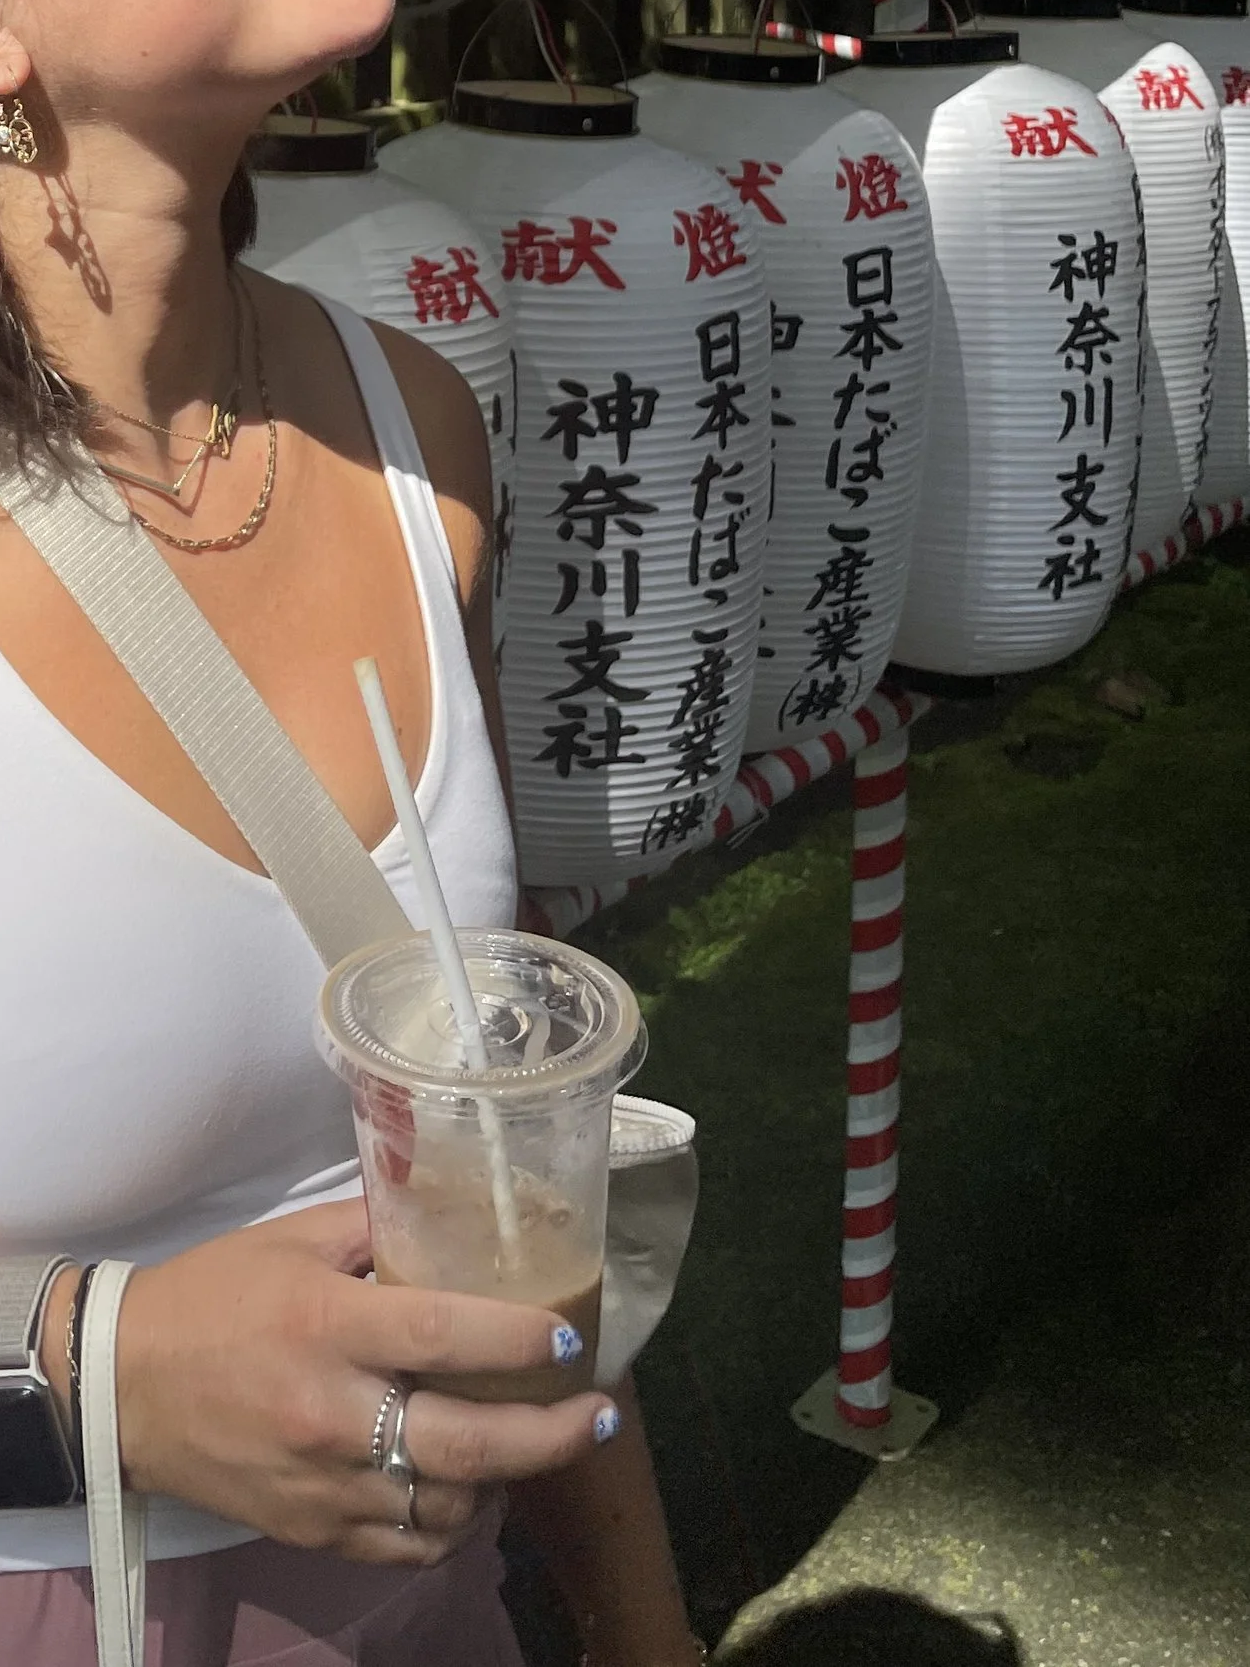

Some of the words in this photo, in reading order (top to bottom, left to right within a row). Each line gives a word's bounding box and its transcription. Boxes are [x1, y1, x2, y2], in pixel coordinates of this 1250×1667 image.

[1002, 107, 1098, 158] 献
[1134, 64, 1204, 111] 献
[404, 246, 499, 324] 献
[501, 216, 626, 291] 献
[779, 246, 903, 732] 日本たばこ産業(株)
[1036, 231, 1120, 601] 神奈川支社
[533, 371, 661, 778] 神奈川支社
[639, 311, 753, 855] 日本たばこ産業(株)
